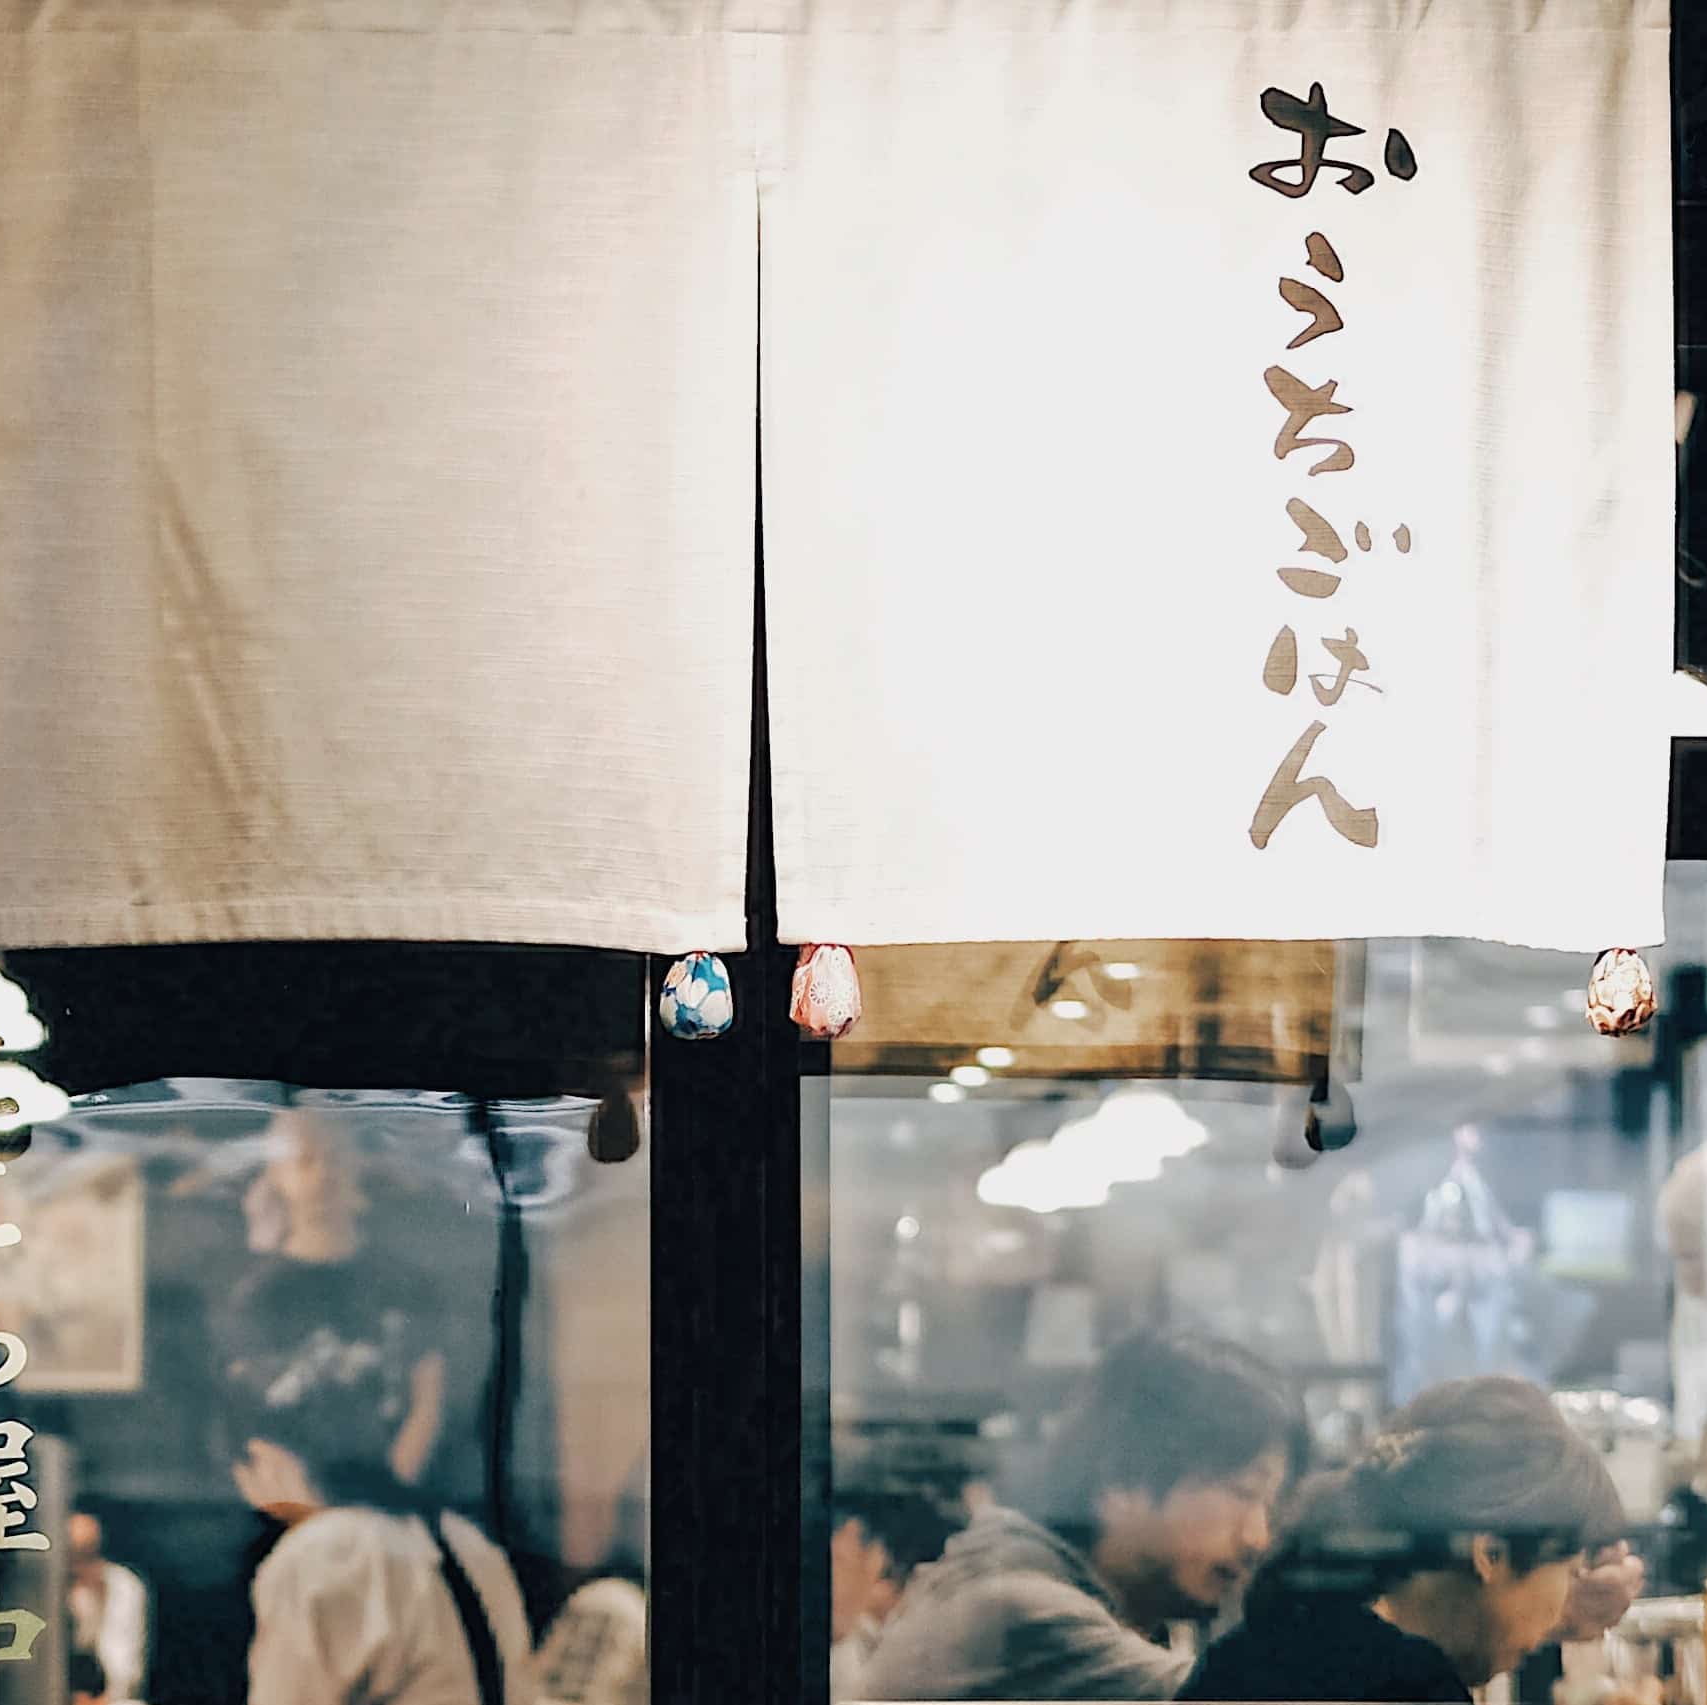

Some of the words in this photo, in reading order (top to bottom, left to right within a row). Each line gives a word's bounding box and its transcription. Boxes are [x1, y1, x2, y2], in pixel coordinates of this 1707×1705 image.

[1249, 82, 1417, 849] おうちごはん
